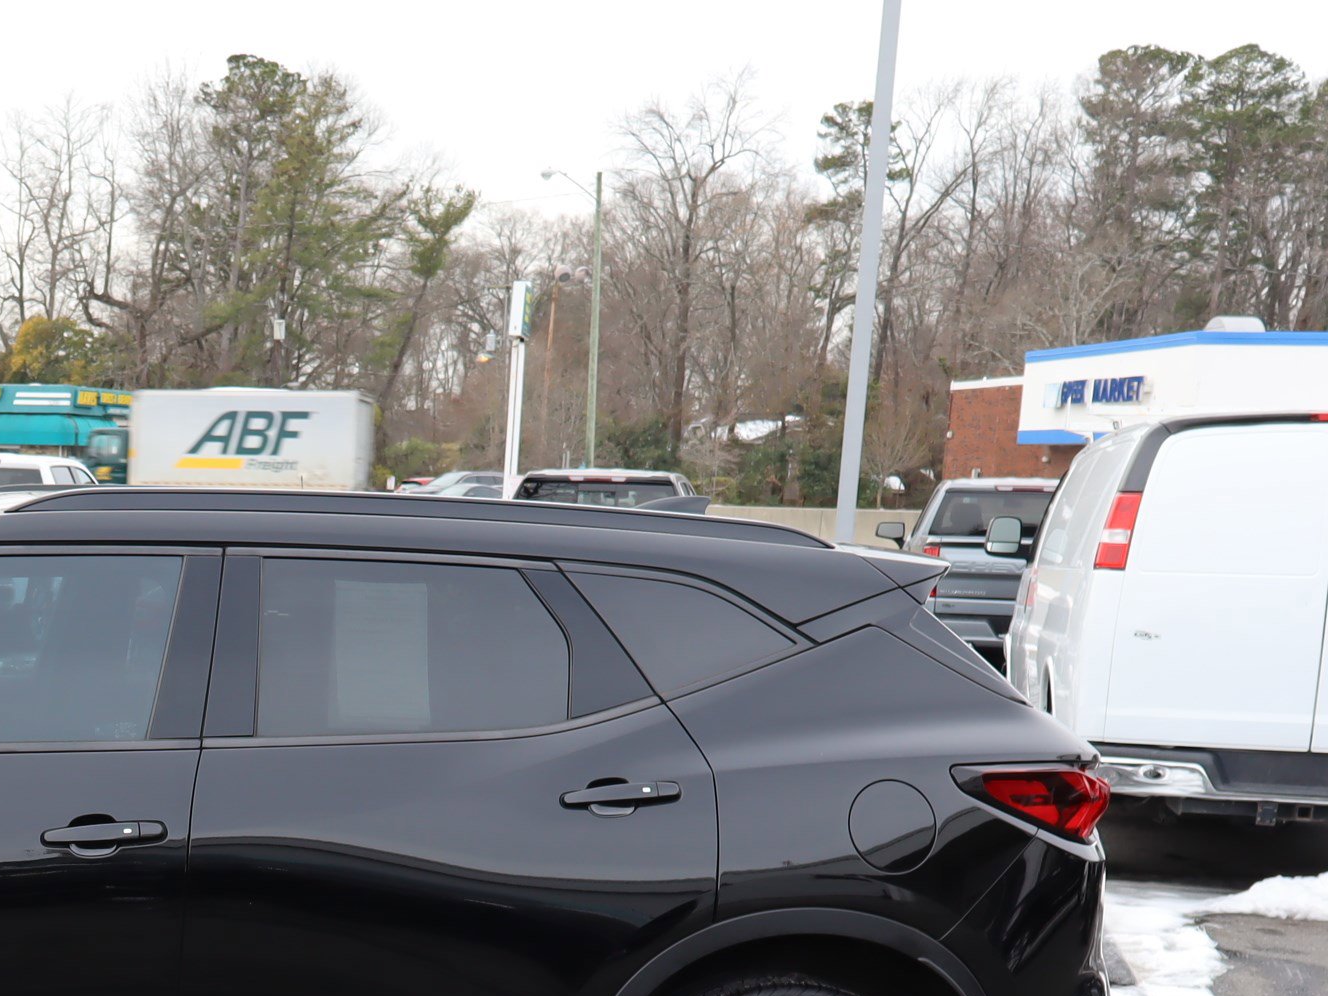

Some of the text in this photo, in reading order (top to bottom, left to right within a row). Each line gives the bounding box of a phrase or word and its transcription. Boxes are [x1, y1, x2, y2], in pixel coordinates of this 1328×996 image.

[1092, 376, 1145, 403] MARKET
[186, 410, 312, 456] ABF
[245, 458, 299, 472] Freight
